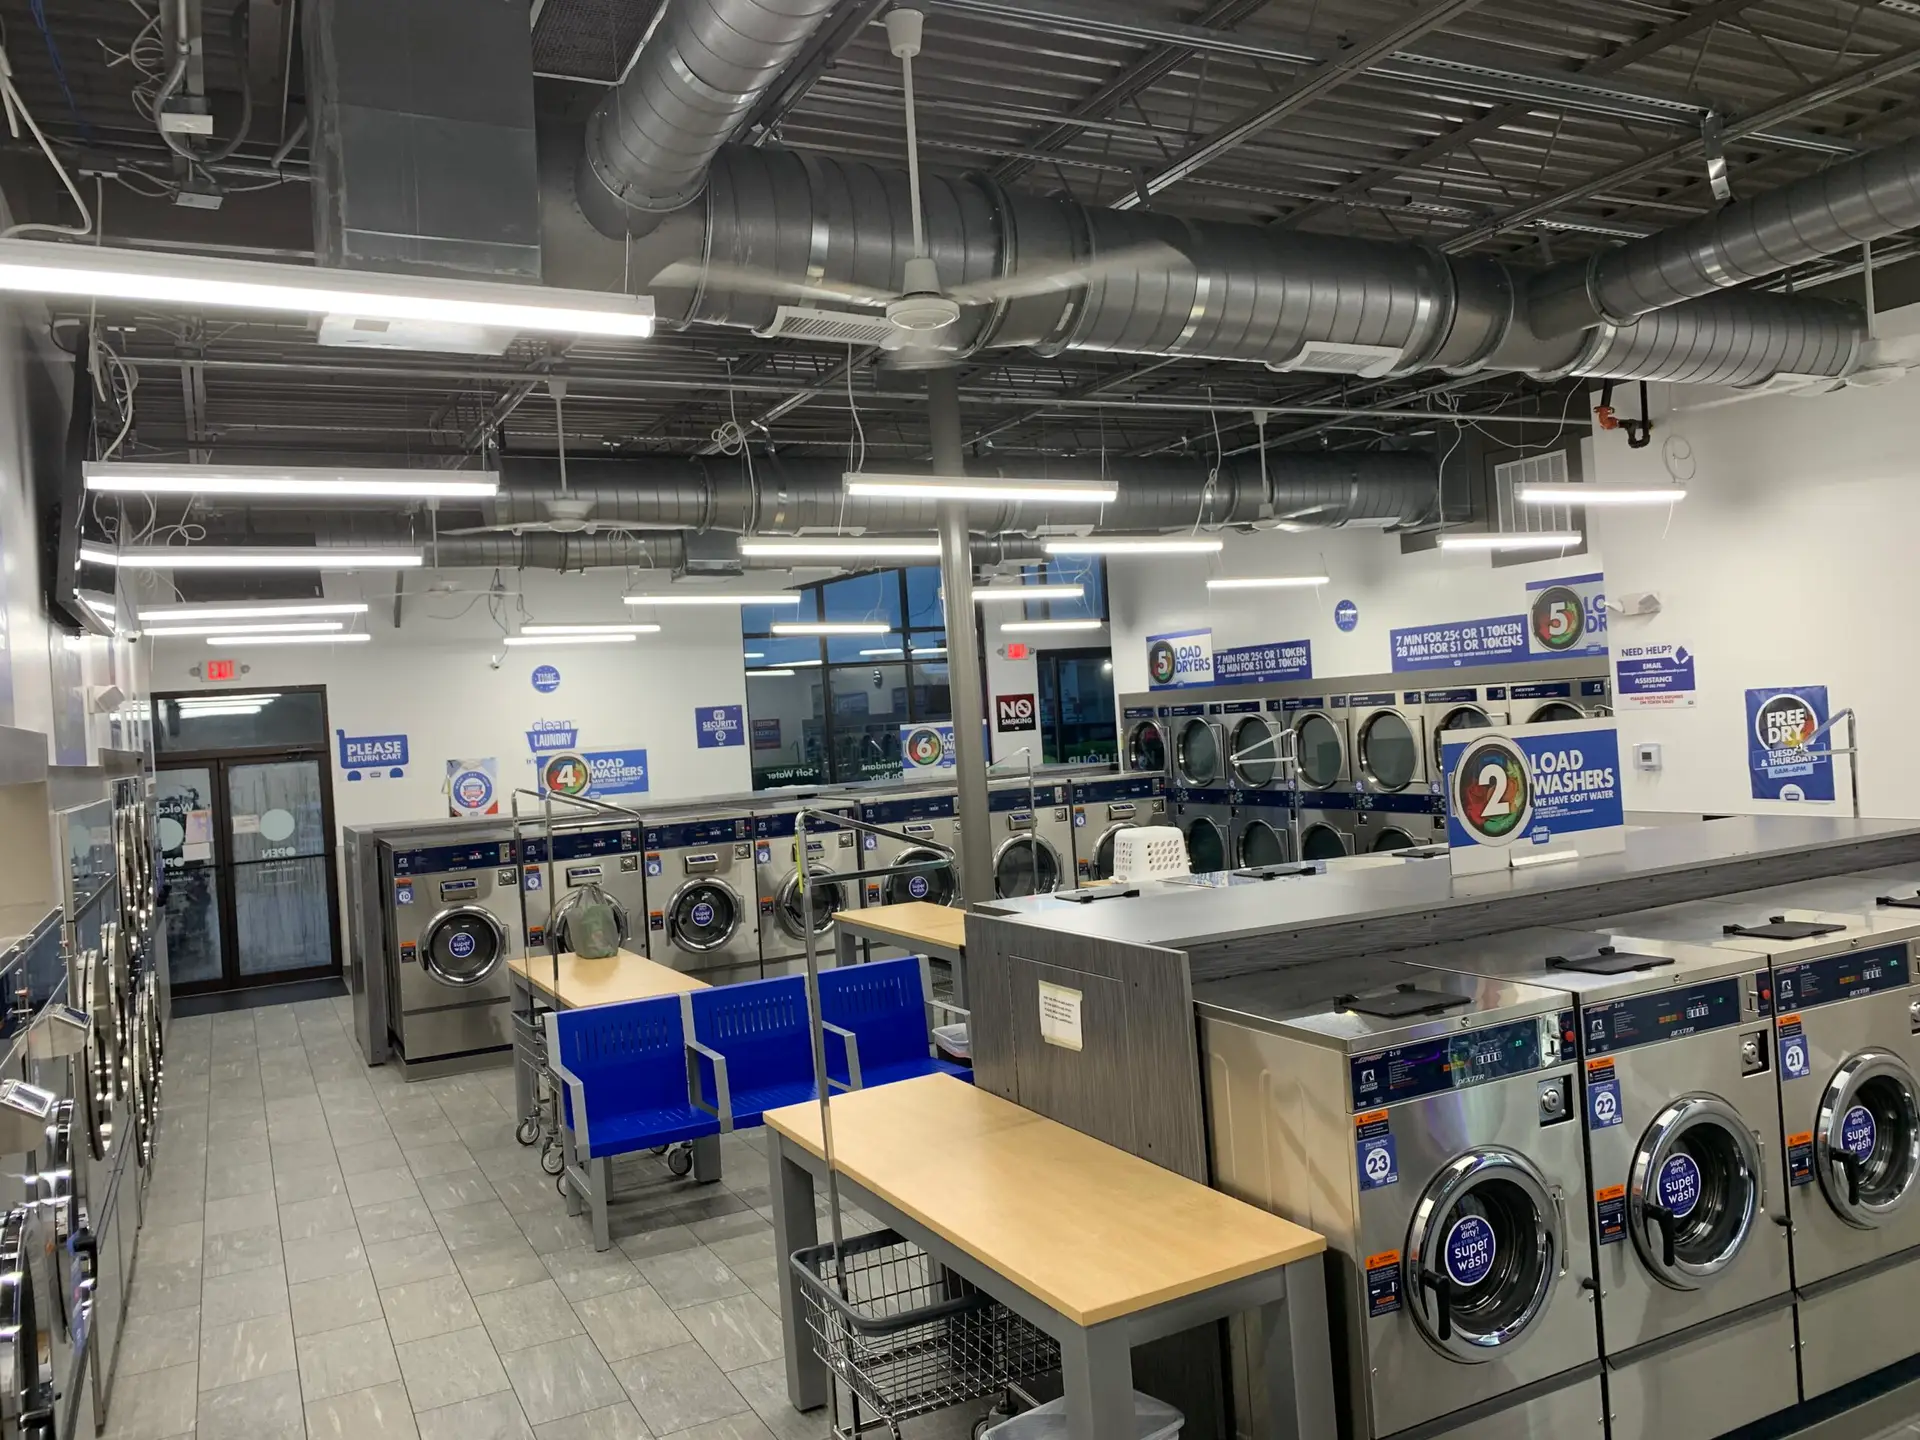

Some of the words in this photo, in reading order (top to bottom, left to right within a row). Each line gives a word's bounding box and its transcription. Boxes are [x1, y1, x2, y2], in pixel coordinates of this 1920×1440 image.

[1584, 594, 1605, 615] LO
[1549, 601, 1568, 636] 5
[1396, 636, 1402, 646] 7
[1403, 634, 1421, 646] MIN
[1423, 632, 1442, 644] FOR
[1462, 628, 1477, 639] OR
[1480, 627, 1484, 638] 1
[1487, 623, 1522, 637] TOKEN
[1175, 645, 1202, 660] LOAD
[1396, 647, 1408, 657] 28
[1409, 644, 1428, 656] MIN
[1429, 642, 1448, 654] FOR
[1450, 641, 1461, 653] $1
[1463, 639, 1479, 650] OR
[1482, 635, 1523, 649] TOKENS
[1621, 648, 1643, 657] NEED
[1646, 645, 1672, 655] HELP?
[1157, 650, 1168, 674] 5
[1217, 655, 1222, 664] 7
[1223, 655, 1236, 664] MIN
[1237, 653, 1250, 662] FOR
[1264, 650, 1275, 660] OR
[1281, 647, 1306, 657] TOKEN
[1176, 657, 1211, 673] DRYERS
[1217, 664, 1226, 674] 28
[1227, 663, 1240, 673] MIN
[1241, 661, 1254, 671] FOR
[1255, 660, 1264, 670] $1
[1265, 659, 1276, 669] OR
[1278, 656, 1307, 668] TOKENS
[1635, 676, 1673, 684] ASSISTANCE
[1000, 699, 1032, 718] NO
[532, 717, 571, 731] clean
[702, 720, 737, 729] SECURITY
[1002, 717, 1032, 725] SMOKING
[1767, 708, 1805, 727] FREE
[534, 733, 571, 747] LAUNDRY
[1768, 723, 1804, 743] DRY
[347, 741, 401, 756] PLEASE
[917, 738, 932, 758] 6
[348, 754, 379, 763] RETURN
[381, 753, 401, 761] CART
[591, 758, 624, 769] LOAD
[1531, 749, 1583, 774] LOAD
[1761, 759, 1767, 767] &
[1770, 755, 1817, 766] THURSDAYS
[557, 765, 576, 787] 4
[592, 766, 643, 779] WASHERS
[1533, 767, 1614, 796] WASHERS
[1478, 764, 1510, 817] 2
[1534, 798, 1546, 807] WE
[1548, 795, 1568, 805] HAVE
[1570, 793, 1588, 803] SOFT
[1589, 790, 1614, 801] WATER
[1670, 1026, 1695, 1037] DEXTER
[1788, 1052, 1801, 1068] 21
[1457, 1073, 1485, 1086] DEXTER
[1597, 1099, 1614, 1115] 22
[1847, 1126, 1871, 1142] super
[1849, 1136, 1871, 1151] wash
[1368, 1155, 1388, 1174] 23
[1670, 1158, 1684, 1167] super
[1671, 1163, 1686, 1175] dirty?
[1665, 1174, 1694, 1192] super
[1668, 1186, 1695, 1204] wash
[1460, 1220, 1477, 1231] super
[1461, 1226, 1480, 1239] dirty?
[1454, 1238, 1488, 1259] super
[1457, 1251, 1488, 1271] wash
